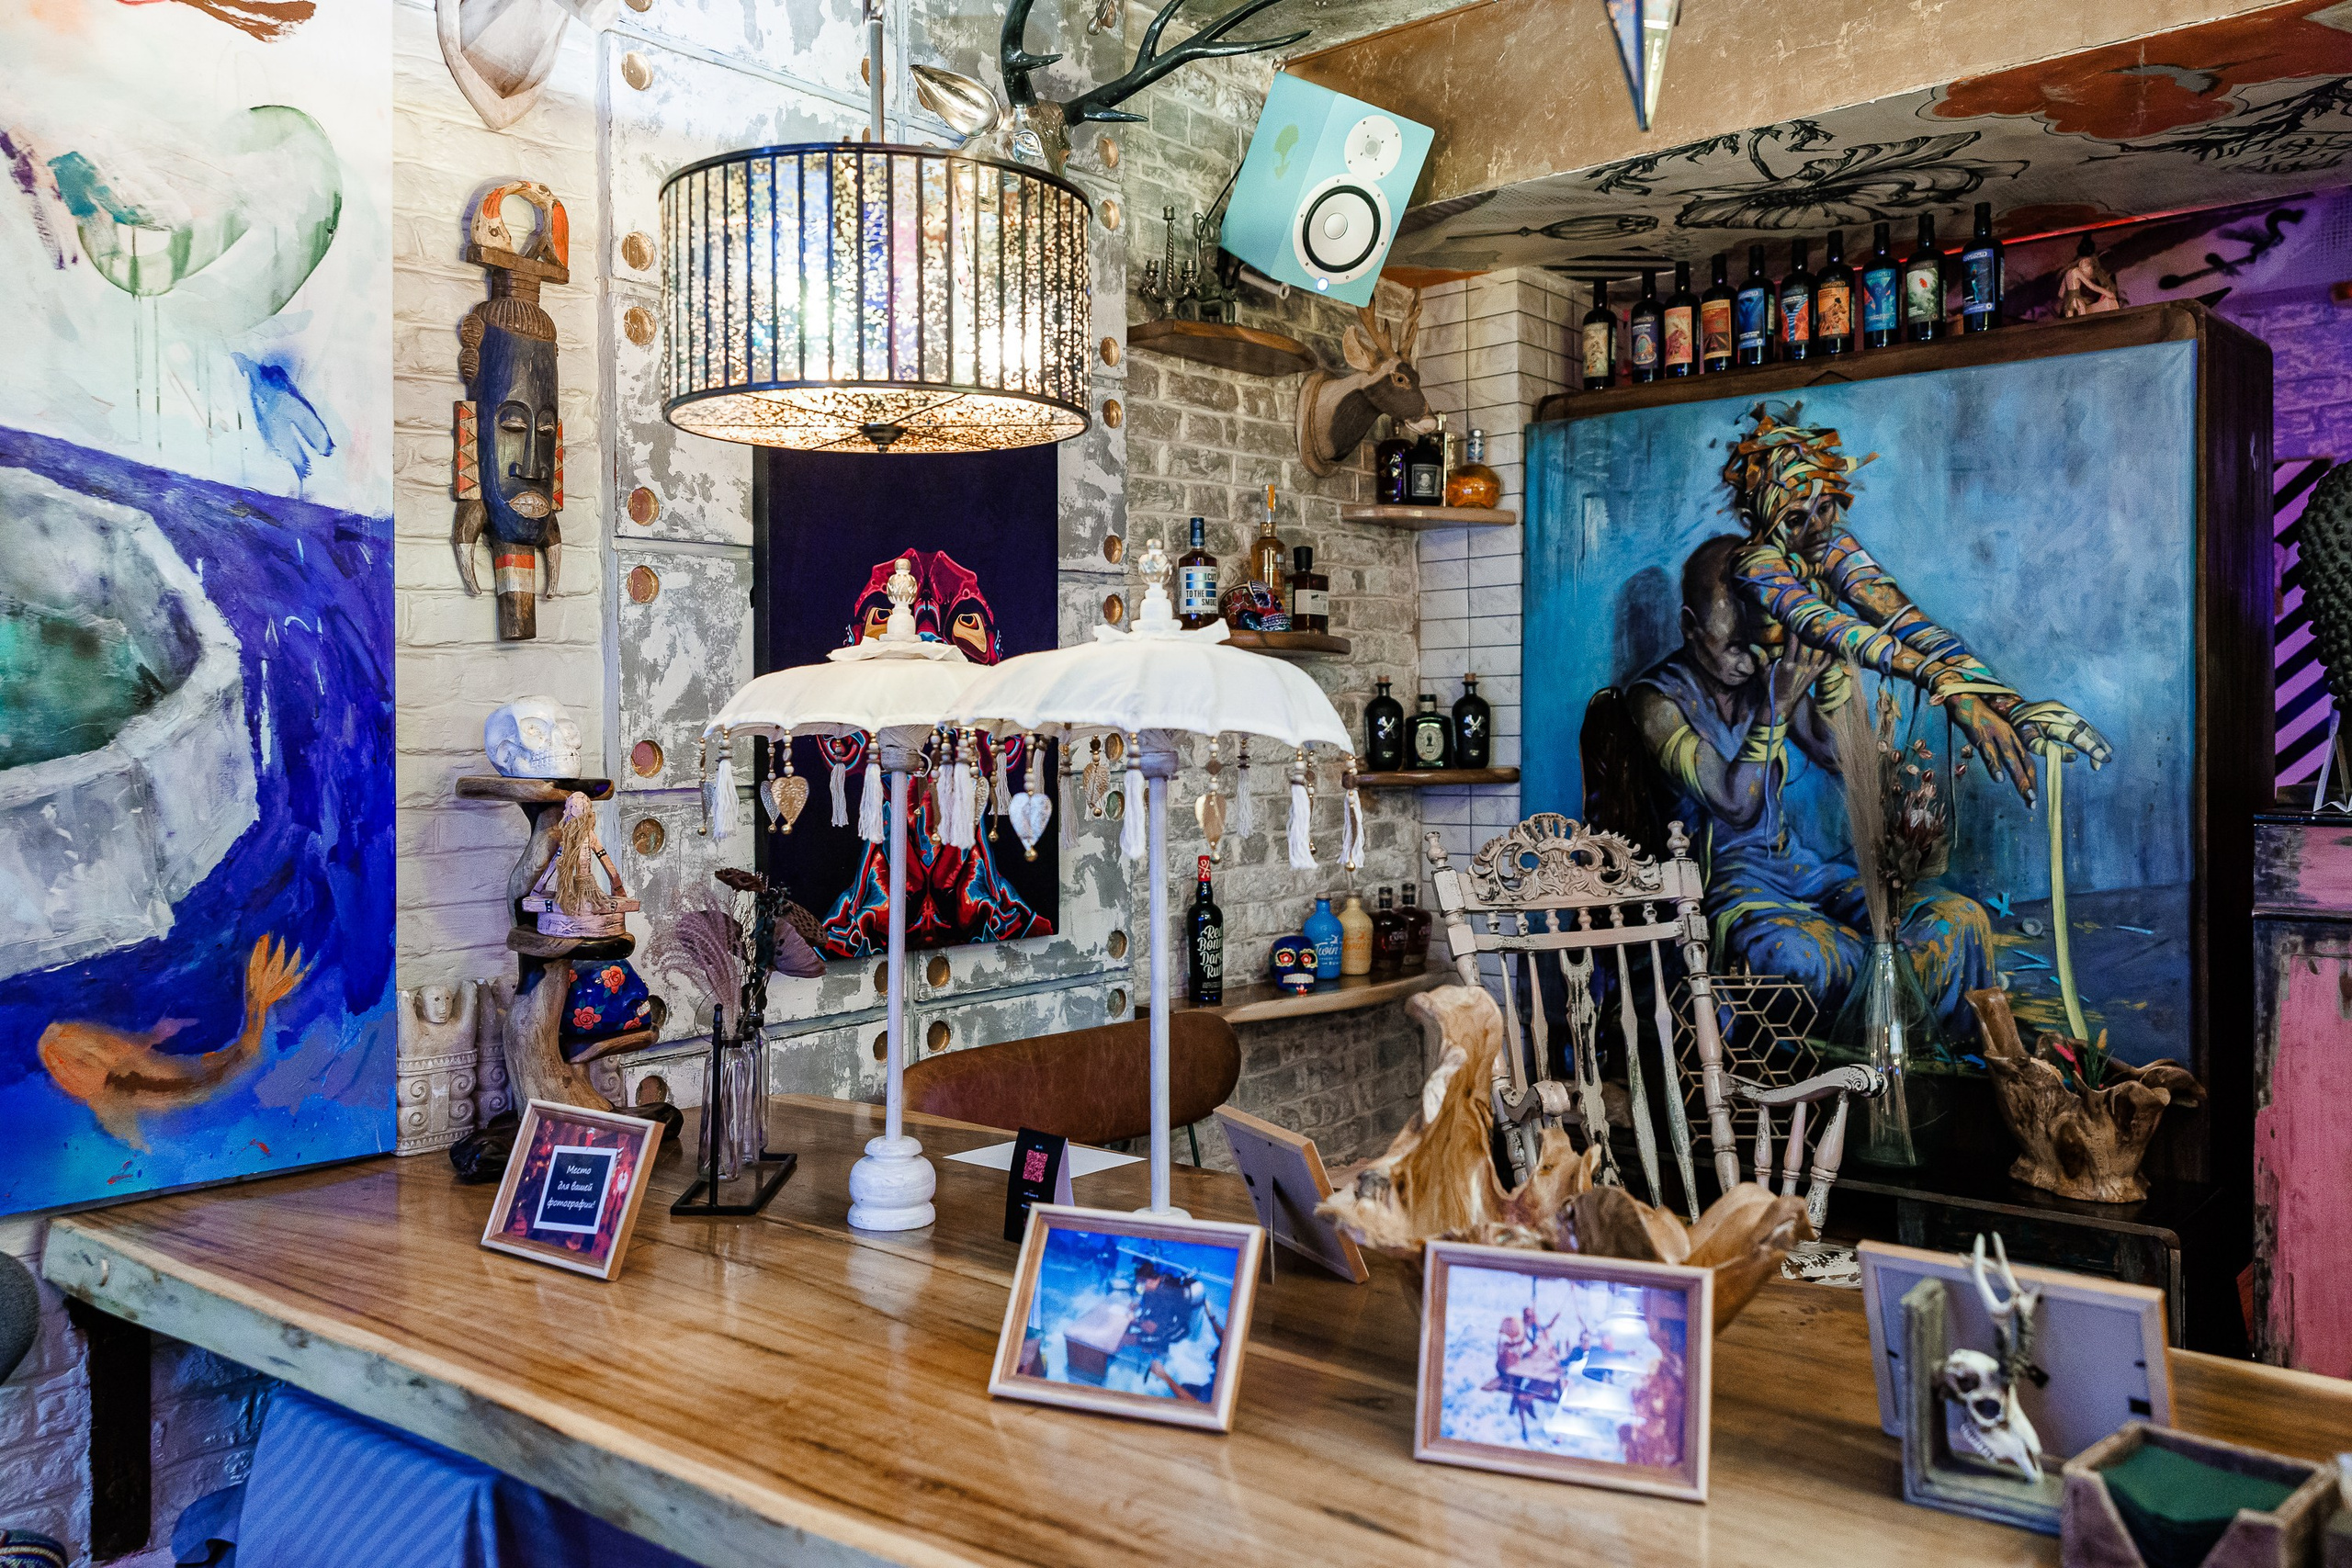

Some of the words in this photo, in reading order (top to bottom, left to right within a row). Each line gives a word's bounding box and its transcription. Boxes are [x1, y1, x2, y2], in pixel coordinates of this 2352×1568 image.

[1186, 590, 1193, 598] TO
[1193, 590, 1204, 598] THE
[1315, 942, 1339, 956] Twin
[566, 1166, 592, 1175] Место
[558, 1180, 570, 1190] для
[571, 1180, 594, 1191] вашей
[547, 1197, 596, 1211] фотографии!
